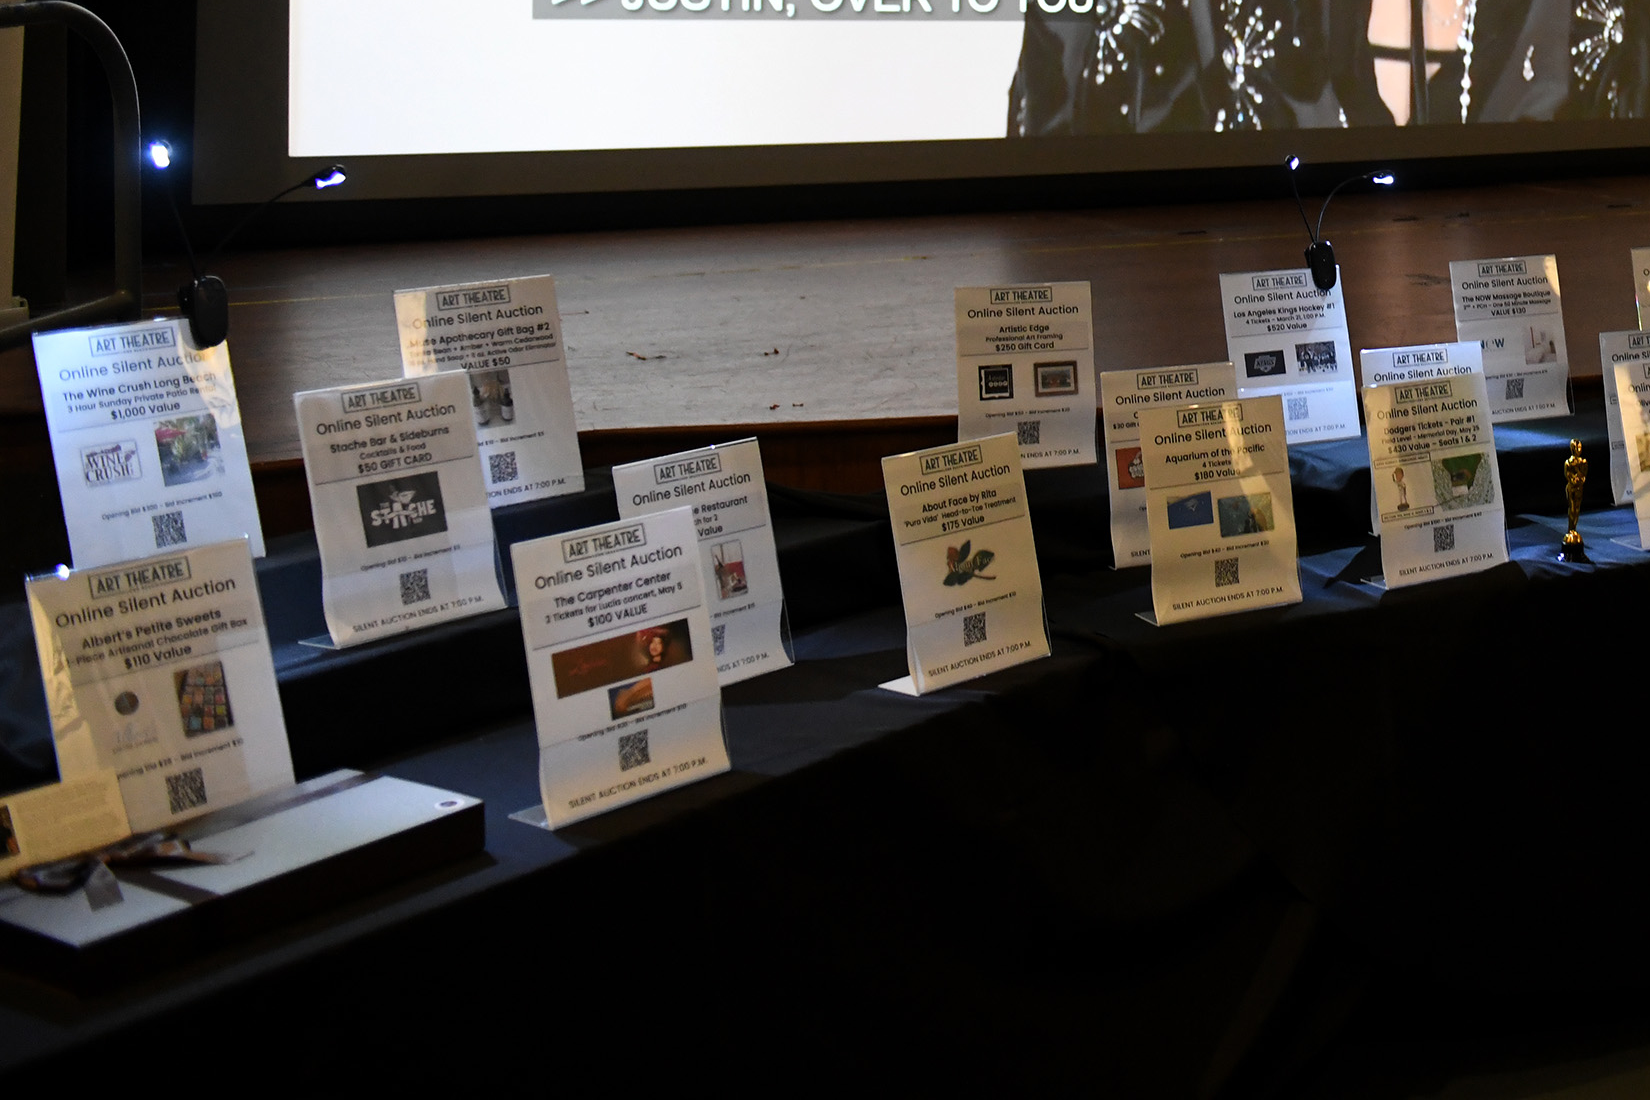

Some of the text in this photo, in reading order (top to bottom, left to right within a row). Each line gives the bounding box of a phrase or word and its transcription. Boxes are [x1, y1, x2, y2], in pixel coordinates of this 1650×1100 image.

[1462, 275, 1548, 290] Online Silent Auction
[1475, 294, 1492, 302] NOW
[1493, 292, 1522, 302] Massage
[1523, 290, 1551, 298] Boutique
[412, 305, 543, 329] Online Silent Auction
[967, 305, 1079, 319] Online Silent Auction
[1233, 310, 1246, 318] Los
[1247, 308, 1276, 318] Angeles
[1278, 306, 1298, 315] Kings
[1299, 305, 1325, 313] Hockey
[439, 328, 495, 347] Apothecary
[497, 327, 514, 338] Gift
[516, 325, 535, 336] Bag
[537, 323, 550, 332] #2
[986, 334, 1024, 343] Professional
[1037, 332, 1063, 341] Framing
[999, 325, 1049, 334] Artistic Edge
[1267, 322, 1308, 332] $520 Value
[96, 331, 171, 352] ART THEATRE
[996, 341, 1055, 352] $250 Gift Card
[59, 363, 108, 382] Online
[112, 358, 153, 374] Silent
[461, 356, 511, 371] VALUE $50
[63, 390, 84, 402] The
[86, 385, 115, 399] Wine
[118, 381, 151, 395] Crush
[153, 377, 181, 391] Long
[348, 387, 417, 409] ART THEATRE
[1115, 386, 1225, 405] Online Silent Auction
[110, 401, 181, 420] $1,000 Value
[316, 403, 456, 435] Online Silent Auction
[1154, 423, 1272, 445] Online Silent Auction
[1384, 415, 1475, 437] Dodgers Tickets Pair #1
[330, 425, 449, 454] Stache Bar & Sideburns
[358, 452, 433, 474] $50 GIFT CARD
[924, 449, 979, 472] ART THEATRE
[1165, 452, 1209, 464] Aquarium
[1210, 449, 1220, 458] of
[1236, 444, 1265, 454] Pacific
[900, 463, 1011, 497] Online Silent Auction
[1194, 467, 1241, 481] $180 Value
[632, 472, 751, 506] Online Silent Auction
[701, 496, 748, 514] Restaurant
[922, 489, 997, 513] About Face by Rita
[941, 514, 985, 532] $175 Value
[97, 562, 185, 593] ART THEATRE
[535, 544, 683, 591] Online Silent Auction
[553, 570, 671, 608] The Carpenter Center
[55, 578, 236, 629] Online Silent Auction
[615, 603, 648, 623] VALUE
[82, 608, 222, 651] Albert's Petite Sweets
[124, 644, 192, 670] $110 Value
